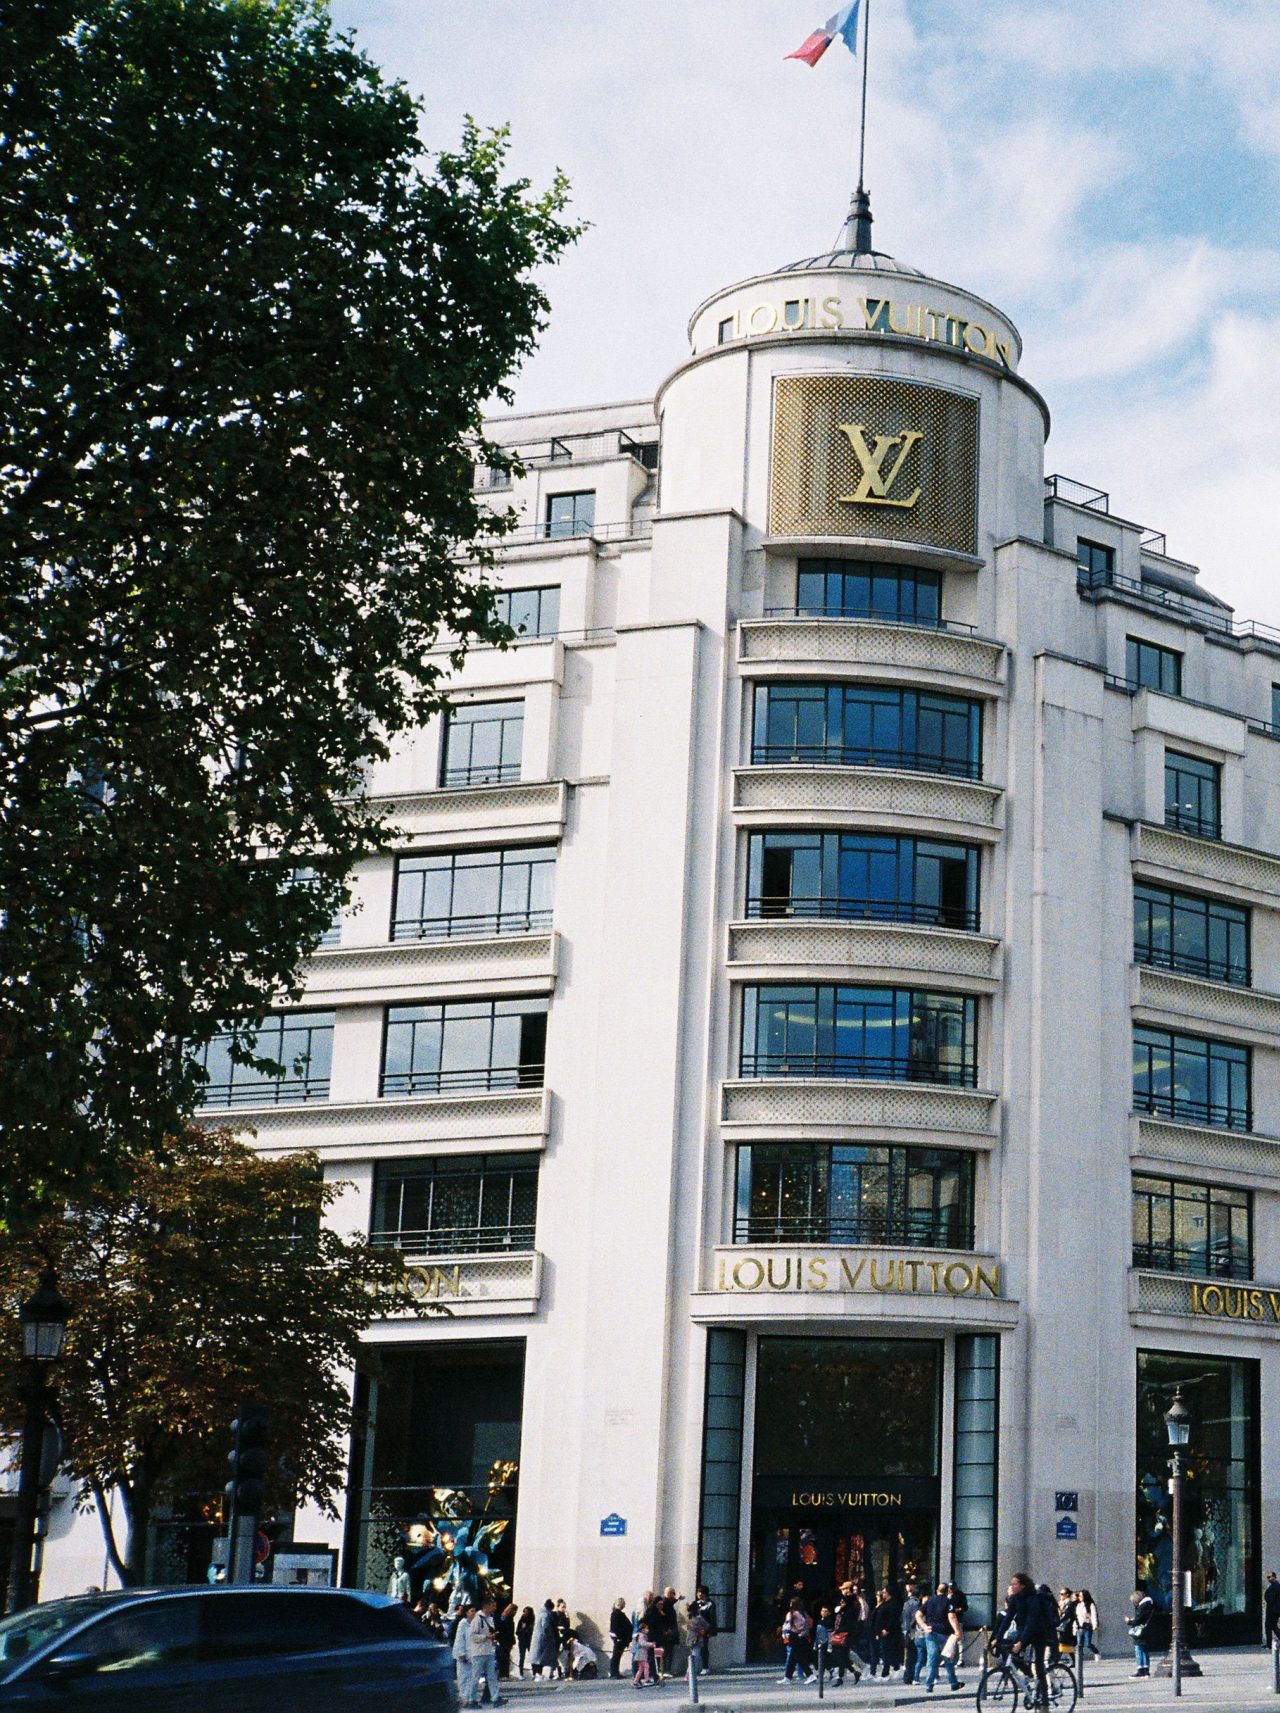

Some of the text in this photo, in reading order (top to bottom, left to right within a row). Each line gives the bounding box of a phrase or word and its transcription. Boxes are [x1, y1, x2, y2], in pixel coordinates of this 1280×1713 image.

[732, 296, 1014, 371] LOUIS VUITTON
[838, 423, 924, 508] LV
[719, 1257, 1000, 1296] LOUIS VUITTON
[1191, 1284, 1264, 1320] LOUIS
[792, 1492, 902, 1506] LOUIS VUITTON
